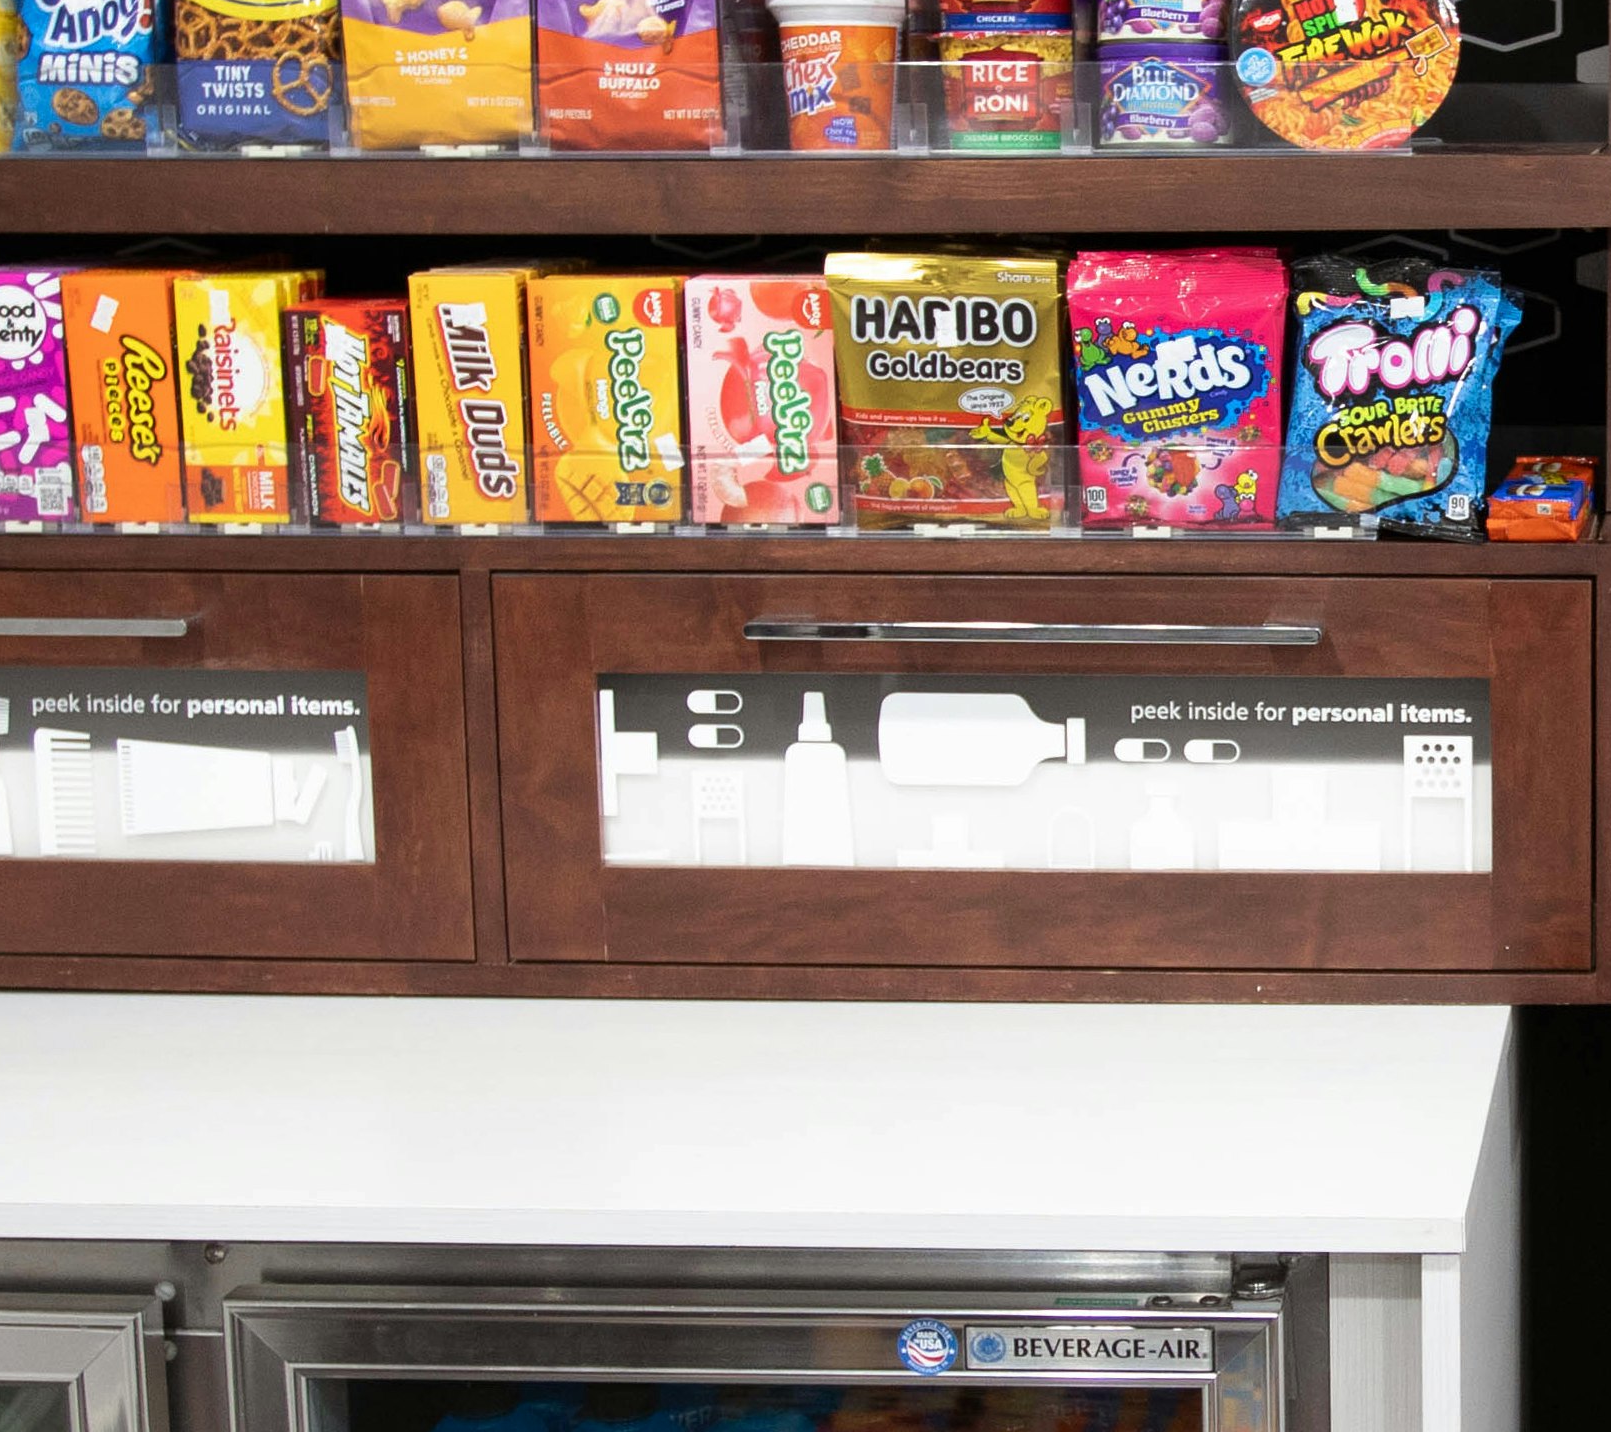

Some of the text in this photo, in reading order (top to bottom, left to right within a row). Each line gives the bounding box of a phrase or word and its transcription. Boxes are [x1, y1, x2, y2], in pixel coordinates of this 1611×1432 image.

[1140, 9, 1189, 22] Blueberry
[599, 78, 660, 90] BUFFALO
[1132, 67, 1176, 85] BLUE
[202, 83, 265, 99] TWISTS
[1113, 84, 1198, 101] DIAMOND
[197, 105, 271, 116] ORIGINAL
[973, 94, 1028, 112] RONI
[1129, 114, 1176, 127] Blueberry
[1309, 308, 1478, 396] Trolli
[868, 352, 1023, 383] Goldbears
[119, 334, 166, 466] Reese's
[1122, 398, 1199, 424] Gummy
[1142, 407, 1219, 433] Clusters
[1316, 416, 1446, 467] Crawlers
[258, 471, 275, 510] MILK
[1087, 488, 1105, 502] 100
[1451, 496, 1465, 510] 90
[31, 694, 361, 718] peek inside for personal items.
[1129, 700, 1473, 726] peek inside for personal items.
[921, 1340, 940, 1350] USA
